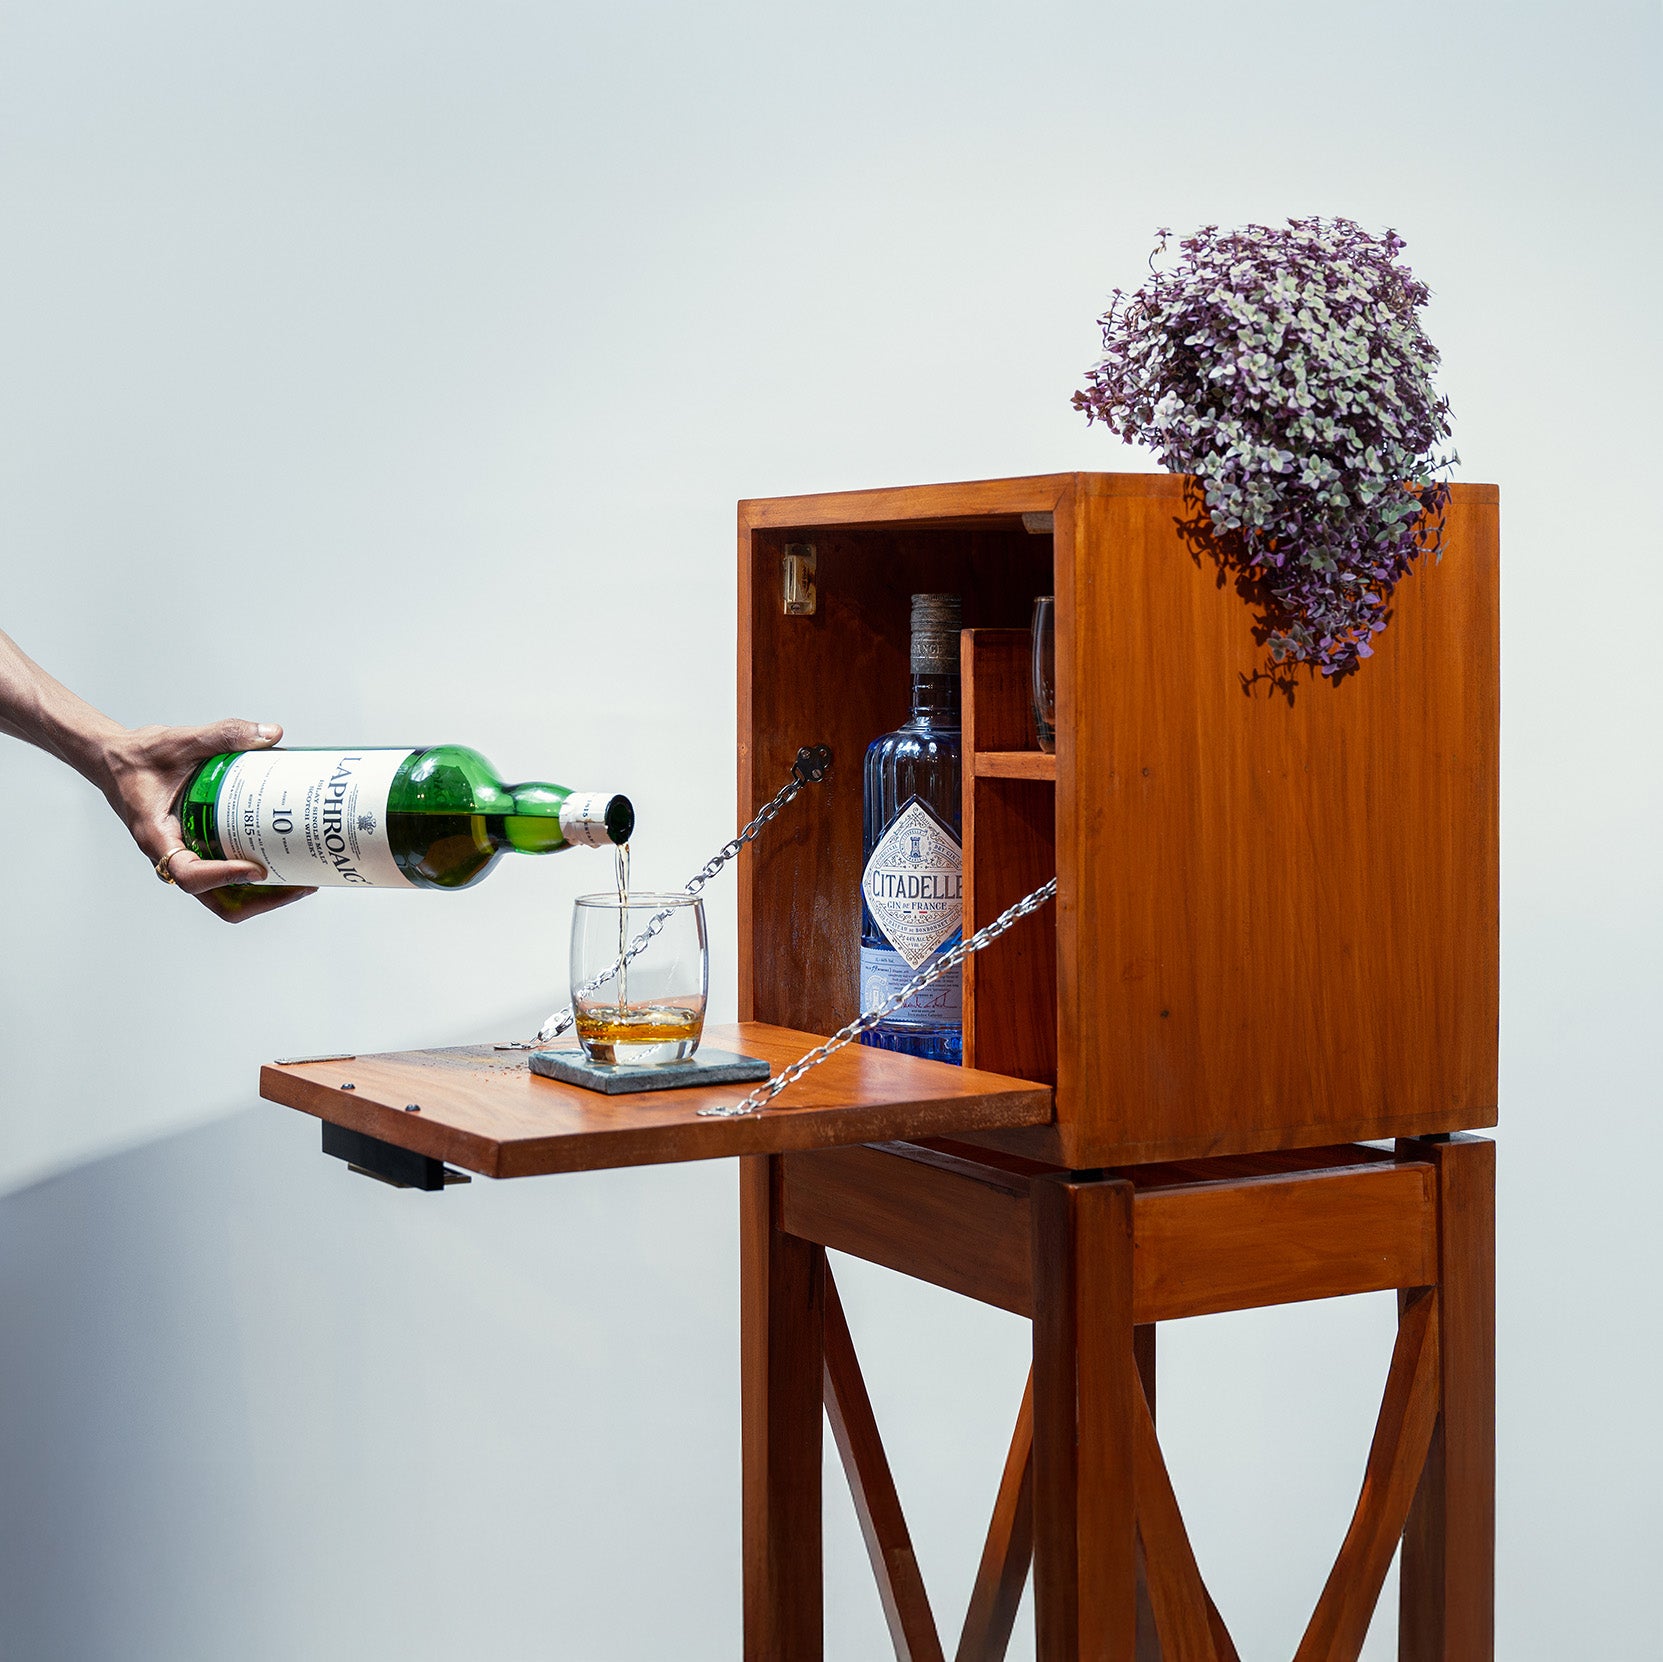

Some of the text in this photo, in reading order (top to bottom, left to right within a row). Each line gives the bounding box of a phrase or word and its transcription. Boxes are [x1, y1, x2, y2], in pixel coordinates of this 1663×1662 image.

[313, 779, 325, 804] ISLAY
[243, 809, 255, 836] 1815
[272, 808, 294, 835] 10
[304, 785, 317, 859] SCOTCH WHISKY
[322, 757, 366, 884] LAPHROAIG
[315, 843, 328, 865] MALT
[872, 870, 962, 900] CITADELLE
[887, 901, 901, 910] GIN
[911, 902, 948, 910] FRANCE
